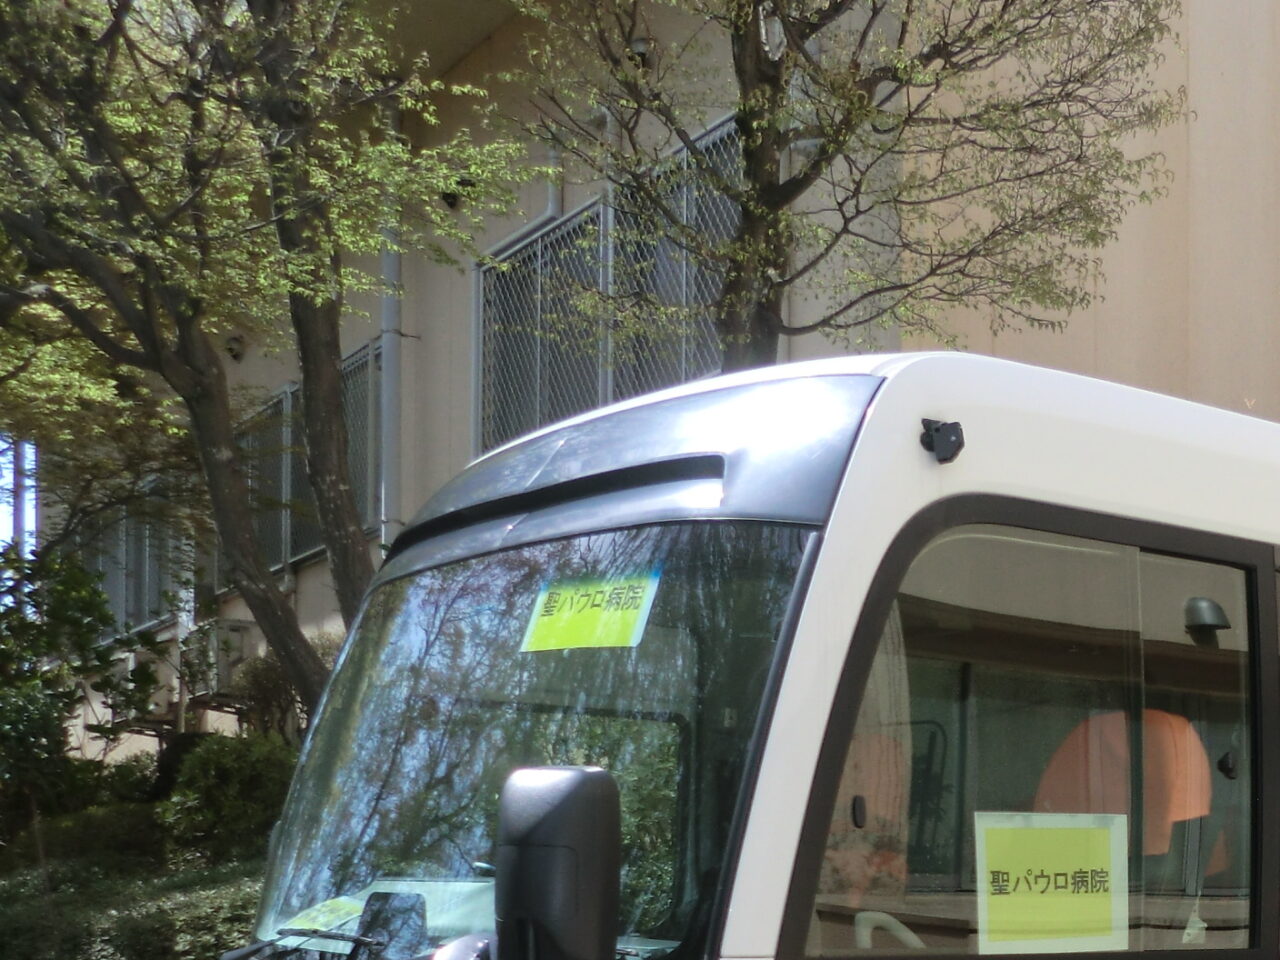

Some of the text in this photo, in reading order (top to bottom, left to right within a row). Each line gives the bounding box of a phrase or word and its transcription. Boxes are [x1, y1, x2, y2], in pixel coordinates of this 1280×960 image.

[541, 584, 645, 617] 聖パウロ病院
[990, 868, 1109, 896] 聖パウロ病院
